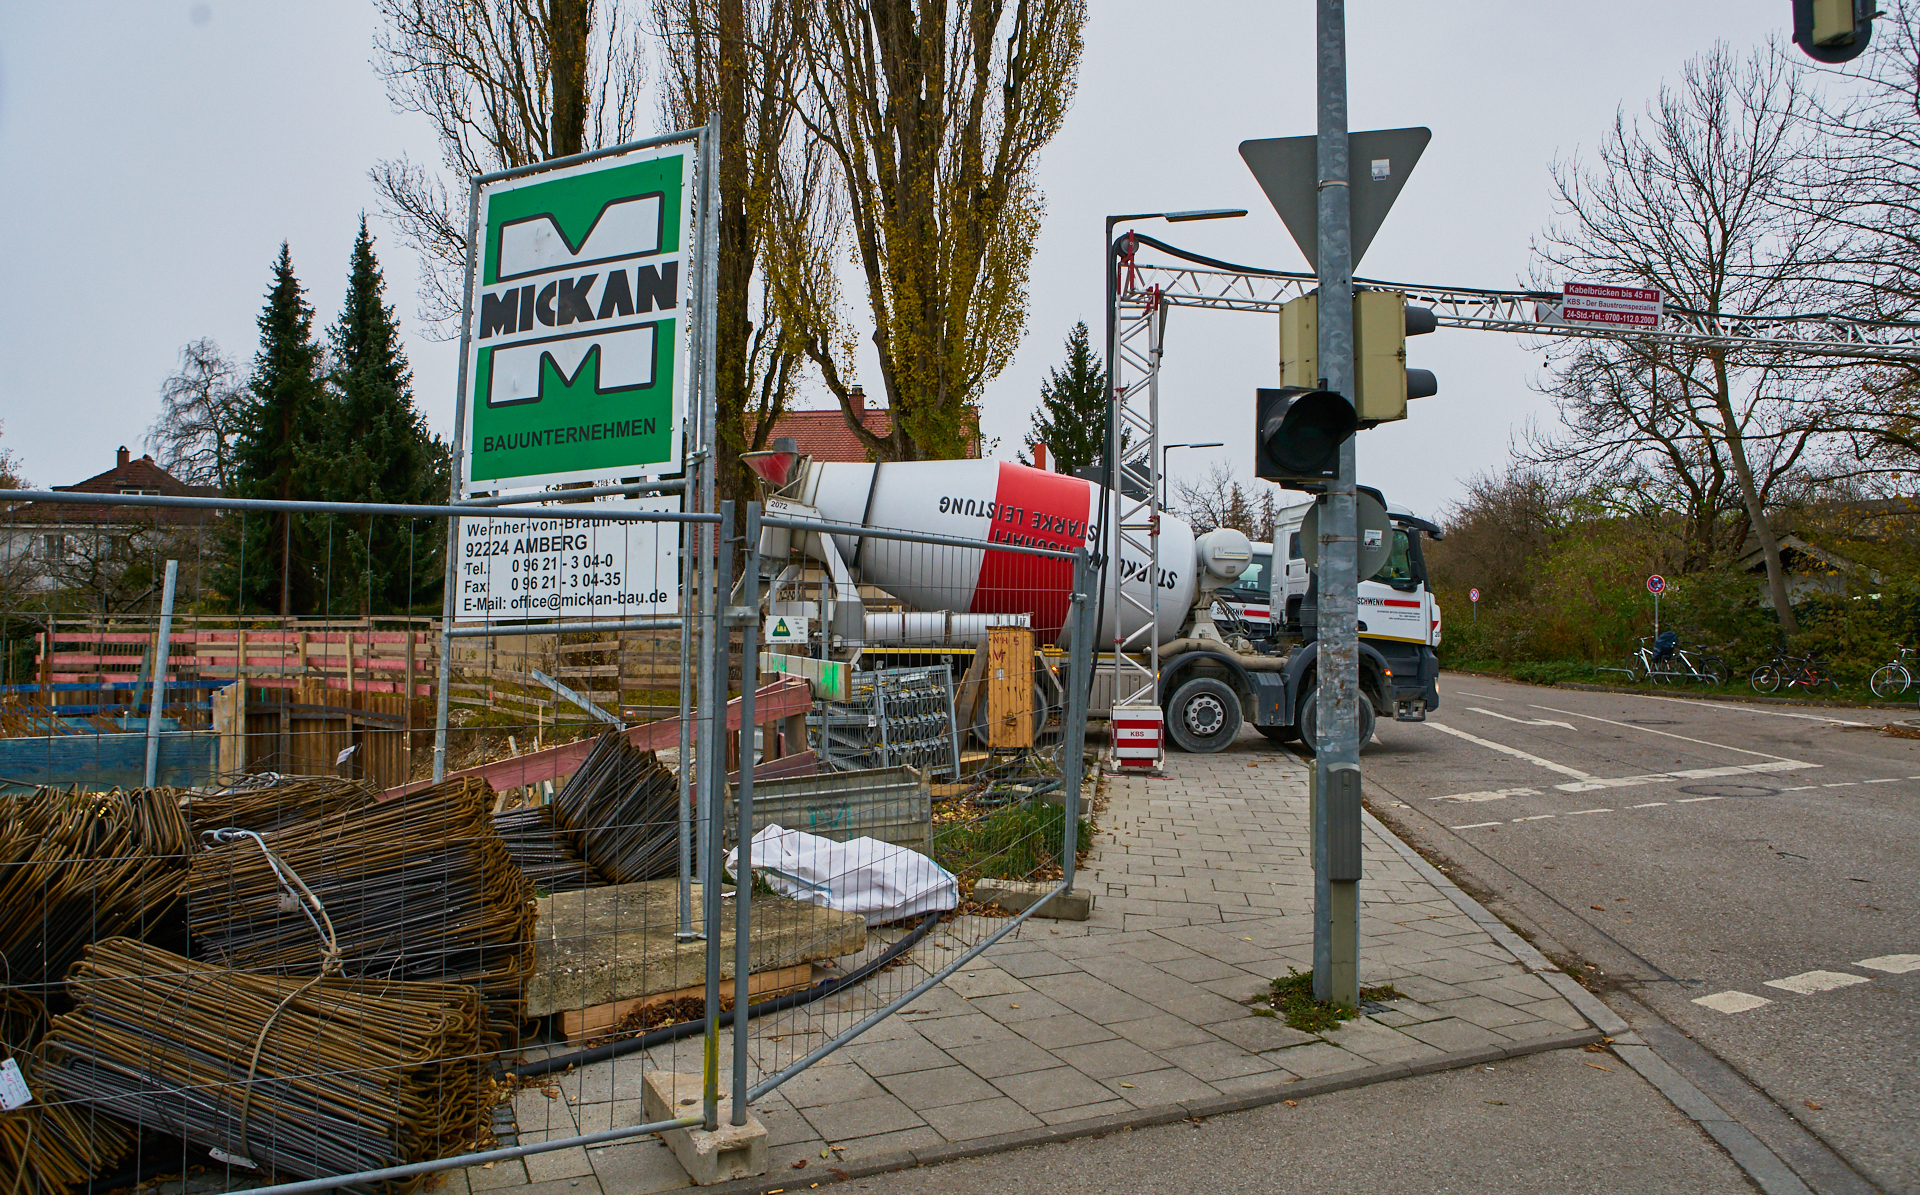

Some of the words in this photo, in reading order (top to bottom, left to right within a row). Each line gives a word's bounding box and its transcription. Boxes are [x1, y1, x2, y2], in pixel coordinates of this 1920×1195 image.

[479, 261, 679, 339] MICKAN
[1569, 285, 1620, 297] Kabelbrücken
[1621, 289, 1633, 297] bis
[1634, 291, 1643, 299] 45
[1566, 298, 1581, 306] KBS
[1598, 301, 1657, 312] Baustromspezialist
[483, 417, 656, 453] BAUUNTERNEHMEN
[771, 501, 788, 510] 2072
[939, 495, 1024, 525] LEISTUNG
[1032, 512, 1098, 541] STARKE
[466, 539, 509, 558] 92224
[513, 534, 588, 555] AMBERG
[512, 559, 520, 573] 0
[523, 558, 538, 572] 96
[542, 556, 558, 571] 21
[571, 555, 580, 569] 3
[583, 553, 613, 569] 04-0
[511, 577, 519, 591] 0
[523, 576, 538, 590] 96
[541, 575, 557, 590] 21
[570, 574, 579, 588] 3
[582, 572, 621, 587] 04-35
[464, 596, 507, 612] E-Mail:
[510, 589, 668, 611] office@mickan-bau.de
[1357, 597, 1384, 606] SCHWENK
